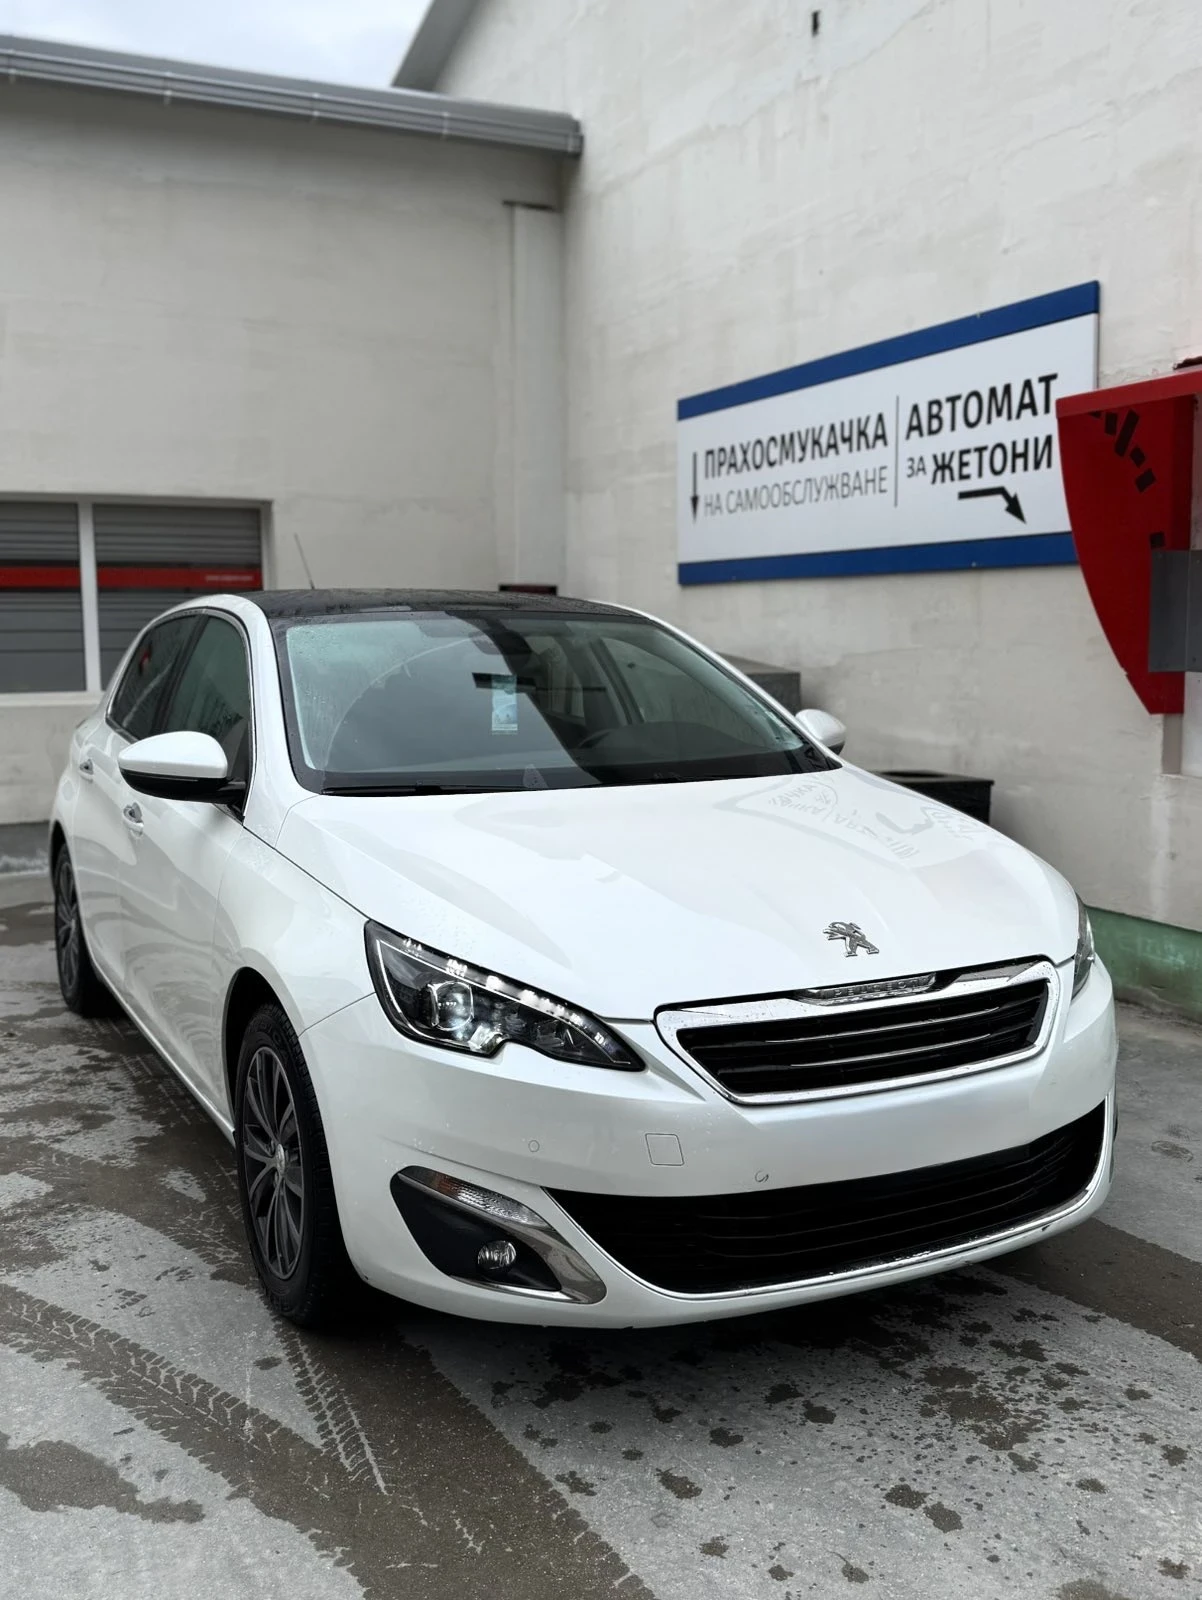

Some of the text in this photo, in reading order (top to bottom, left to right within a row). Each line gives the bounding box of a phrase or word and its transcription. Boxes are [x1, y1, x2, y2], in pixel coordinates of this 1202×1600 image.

[905, 373, 1058, 441] АВТОМАТ
[704, 412, 888, 479] ПРАХОСМУКАЧКА
[906, 434, 1053, 485] ЗА ЖЕТОНИ
[704, 466, 888, 516] НА САМООБСЛУЖВАНЕ
